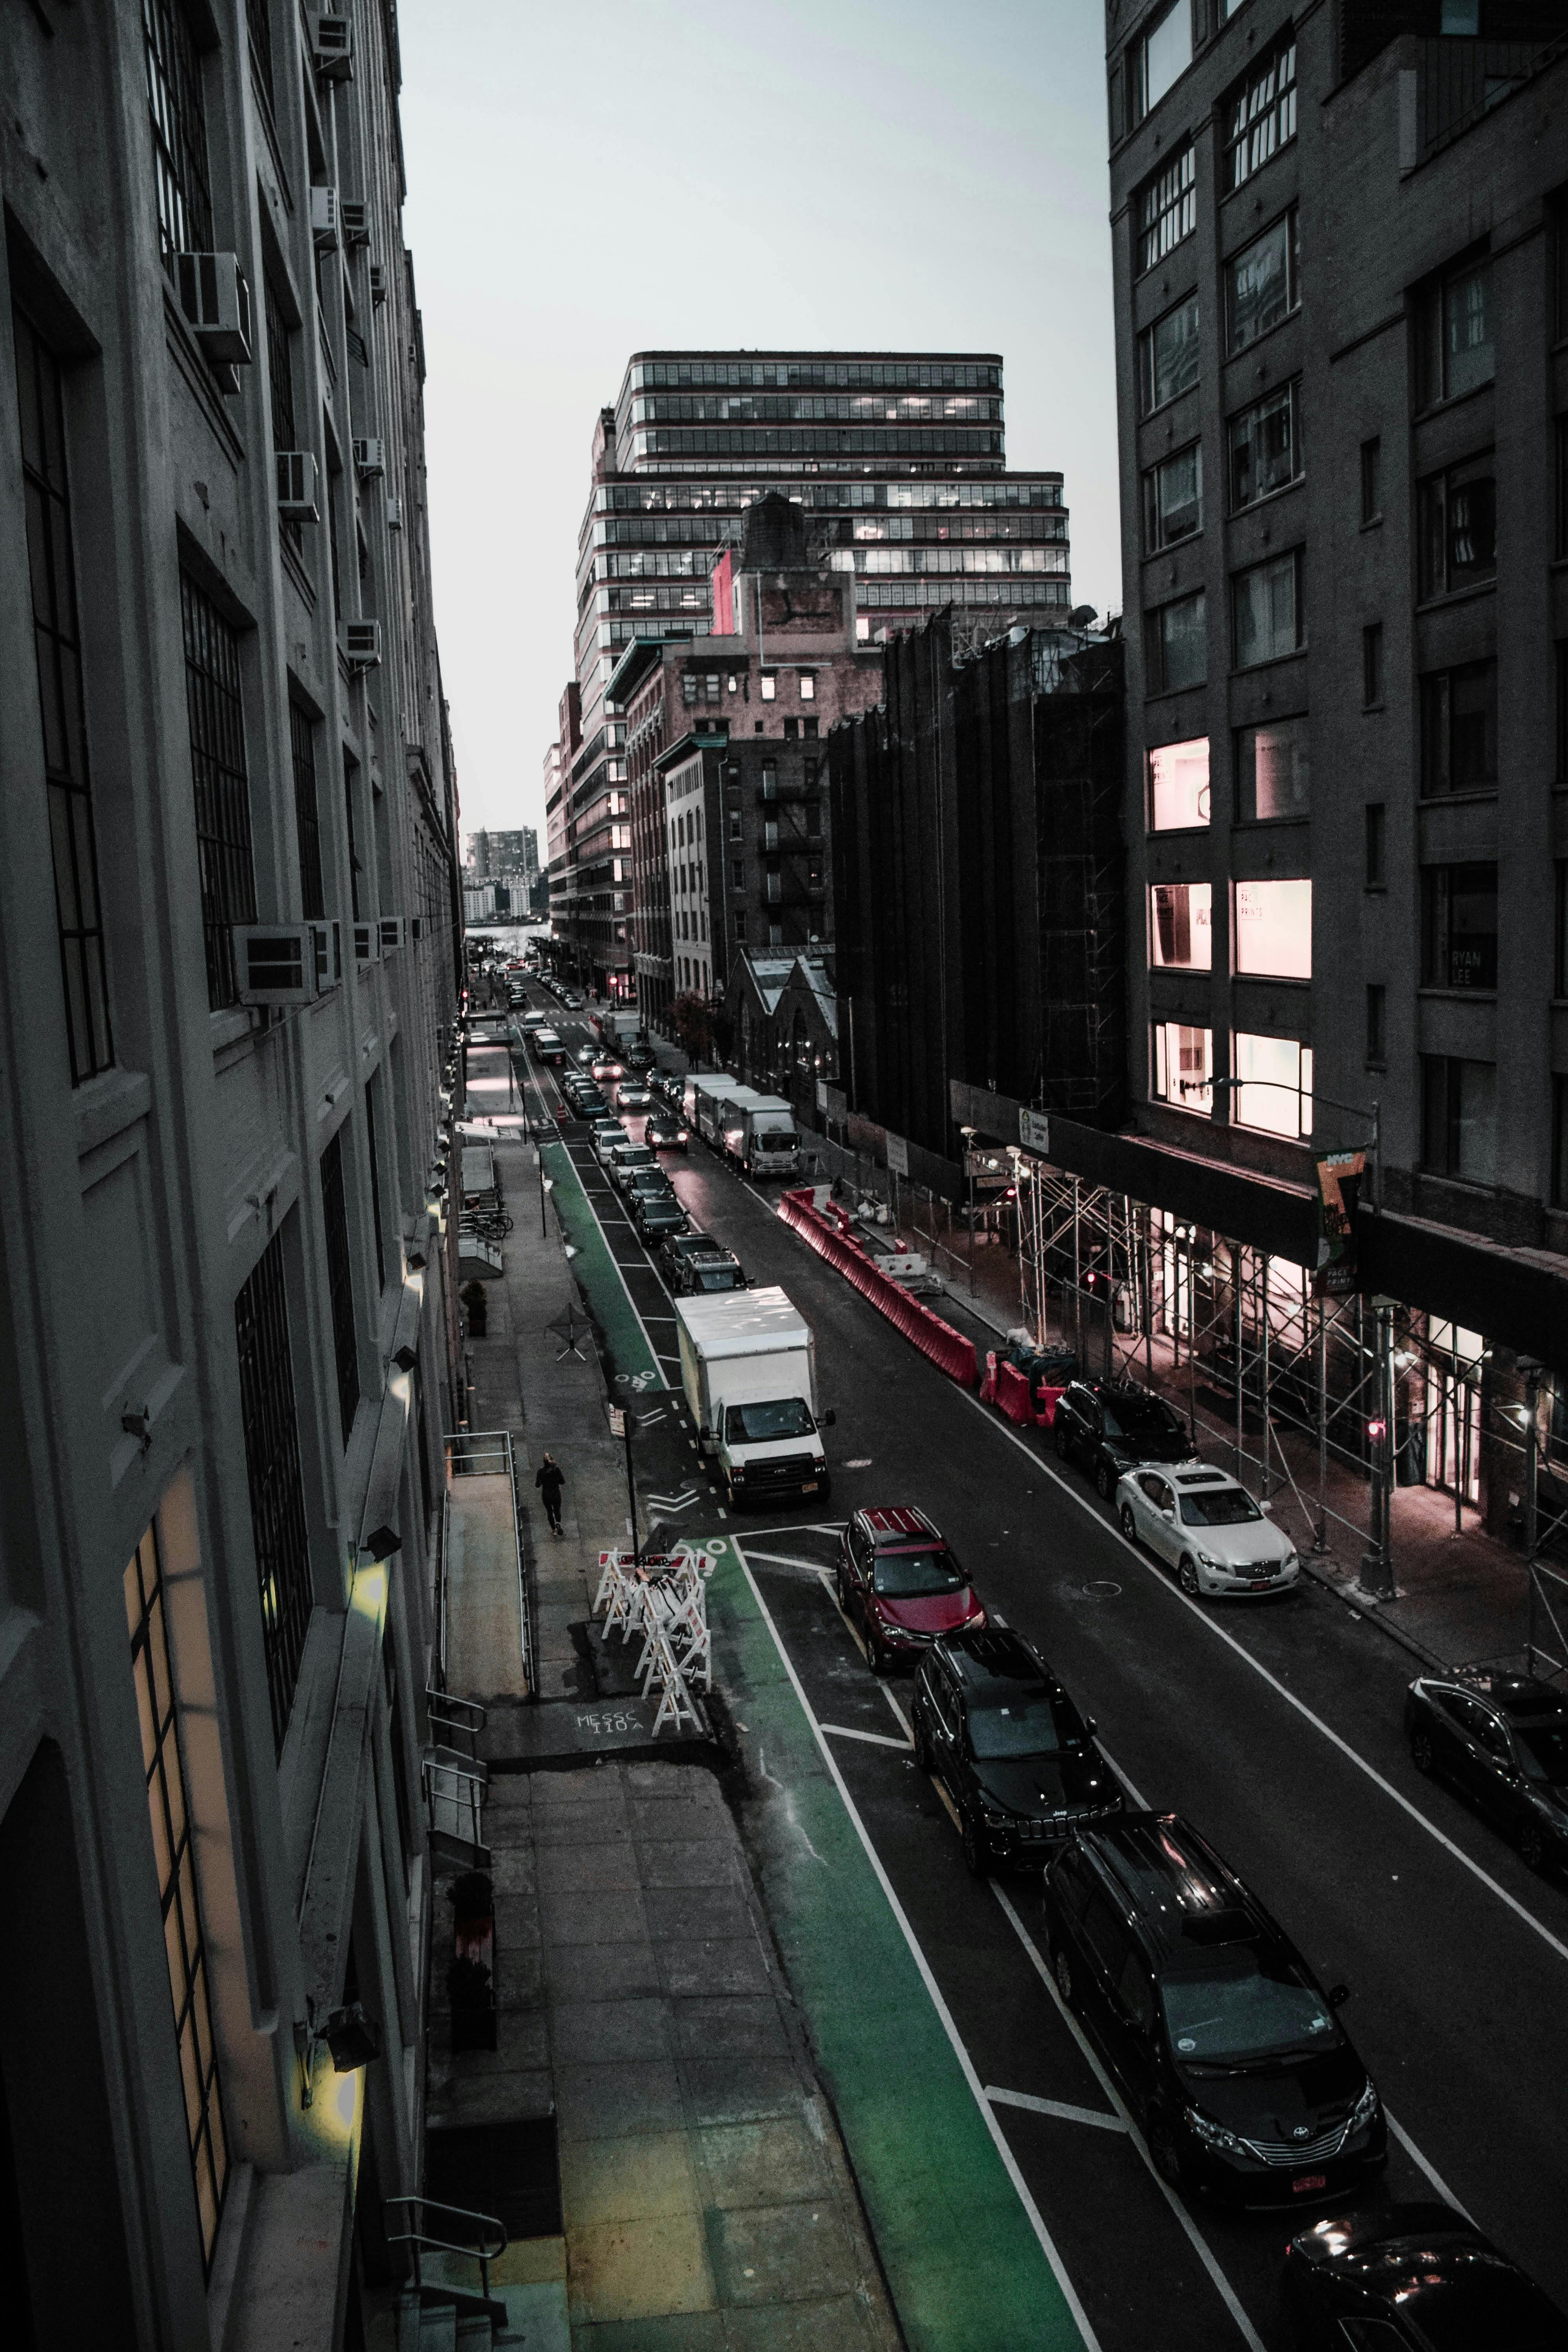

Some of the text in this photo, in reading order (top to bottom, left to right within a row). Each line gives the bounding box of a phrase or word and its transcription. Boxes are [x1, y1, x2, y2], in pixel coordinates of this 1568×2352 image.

[1241, 907, 1262, 916] PRINTS
[1452, 951, 1481, 967] RYAN
[1452, 969, 1471, 984] LEE
[1327, 1153, 1353, 1166] NYC
